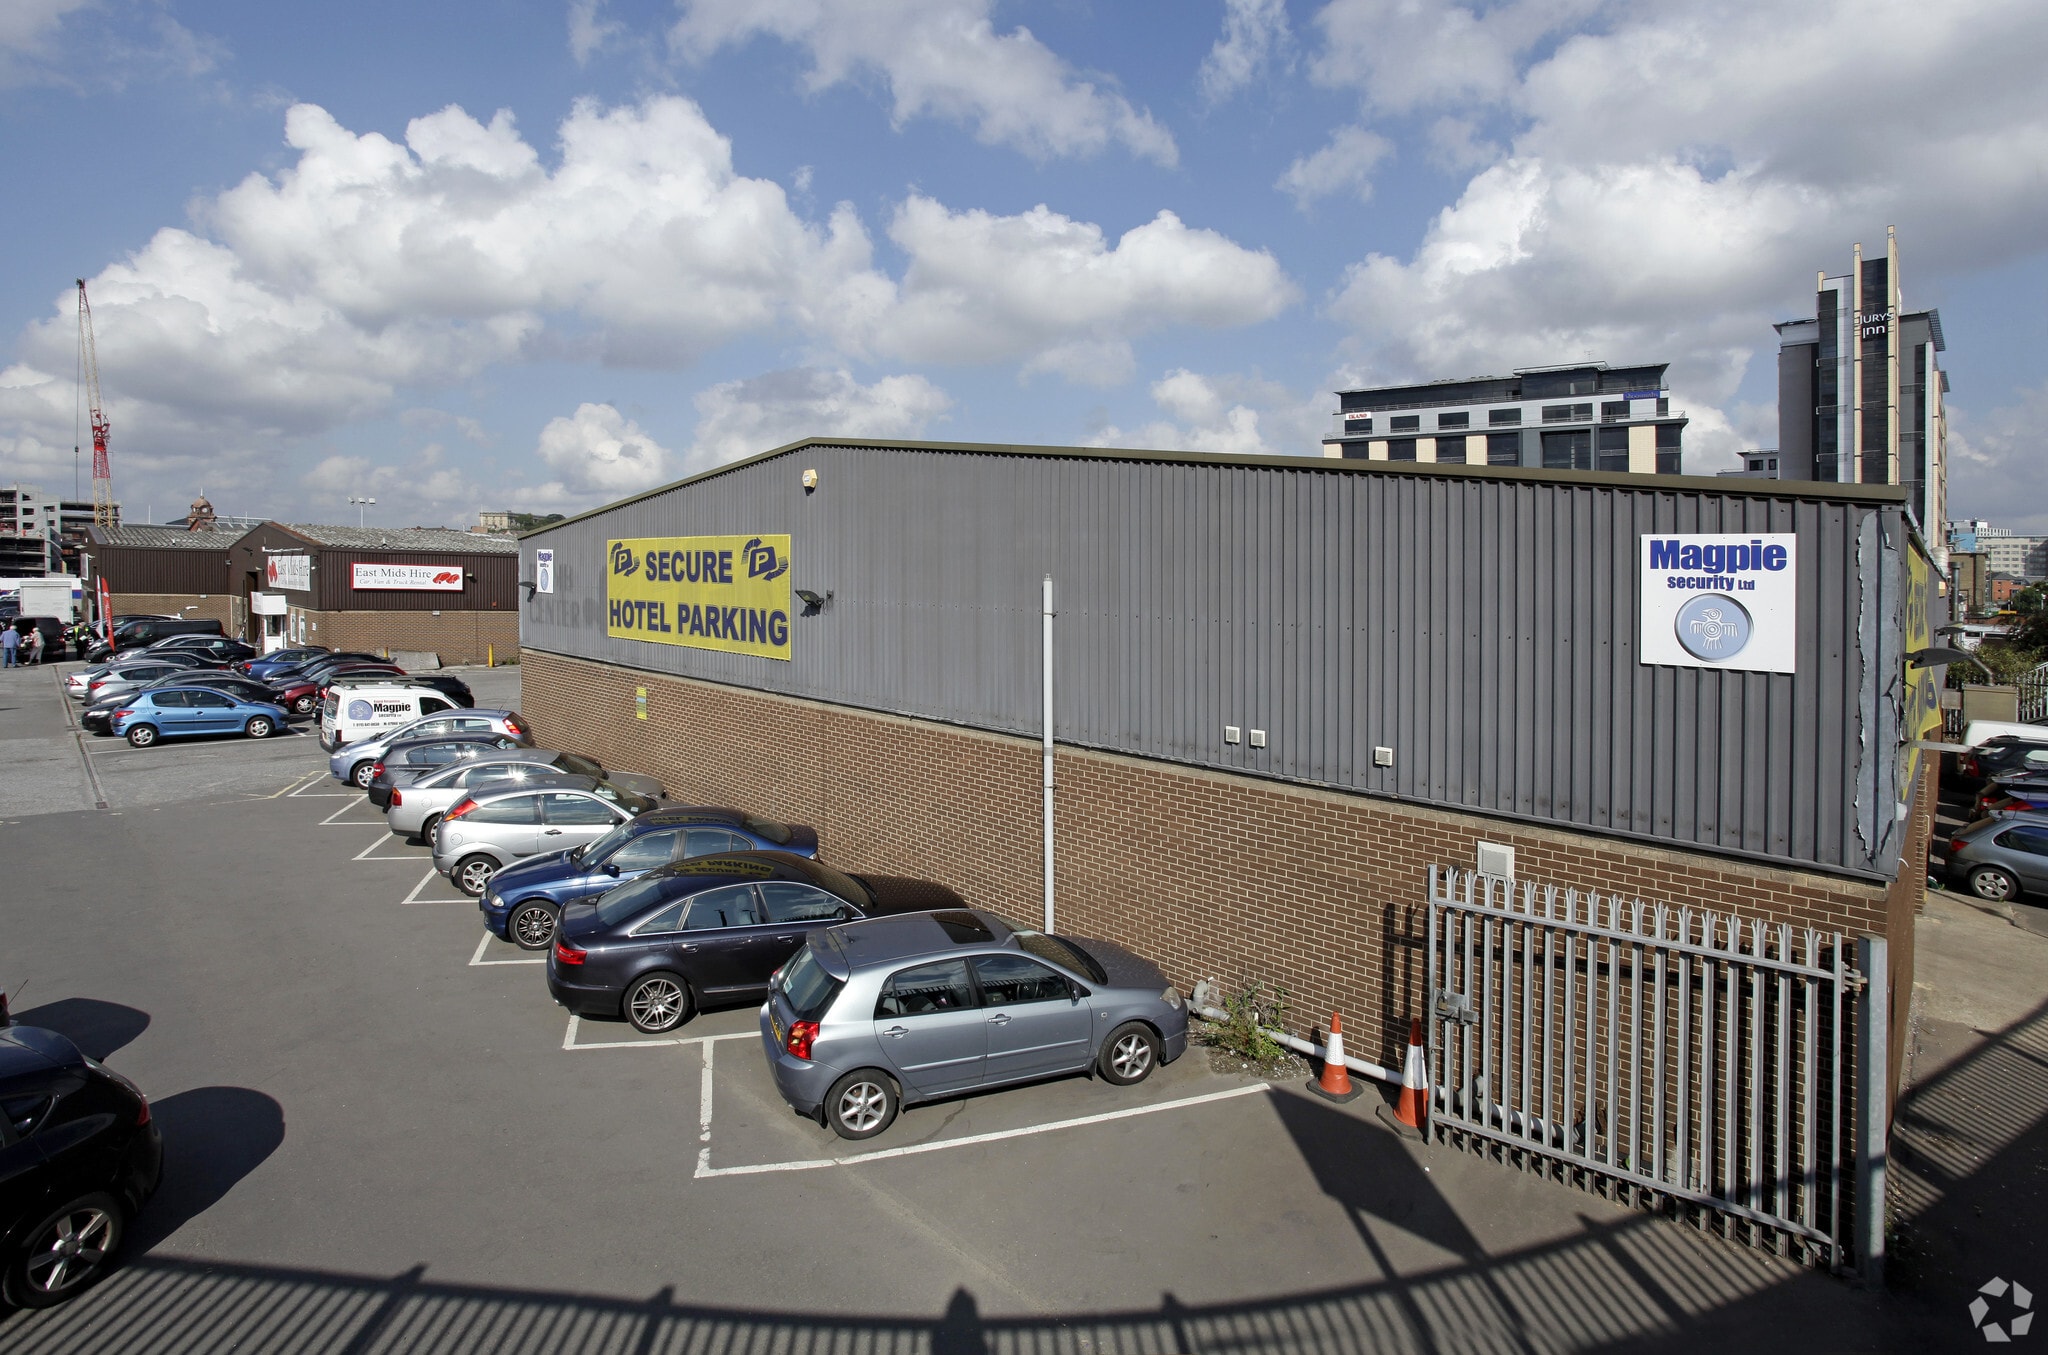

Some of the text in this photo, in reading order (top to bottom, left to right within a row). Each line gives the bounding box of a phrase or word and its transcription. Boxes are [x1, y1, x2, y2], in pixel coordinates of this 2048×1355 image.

[1860, 312, 1894, 325] JURYS
[1650, 539, 1787, 574] Magpie
[355, 567, 432, 579] East Mids Hire
[645, 551, 733, 584] SECURE
[1667, 575, 1756, 591] security Ltd
[609, 599, 788, 647] HOTEL PARKING
[373, 702, 411, 713] Magpie
